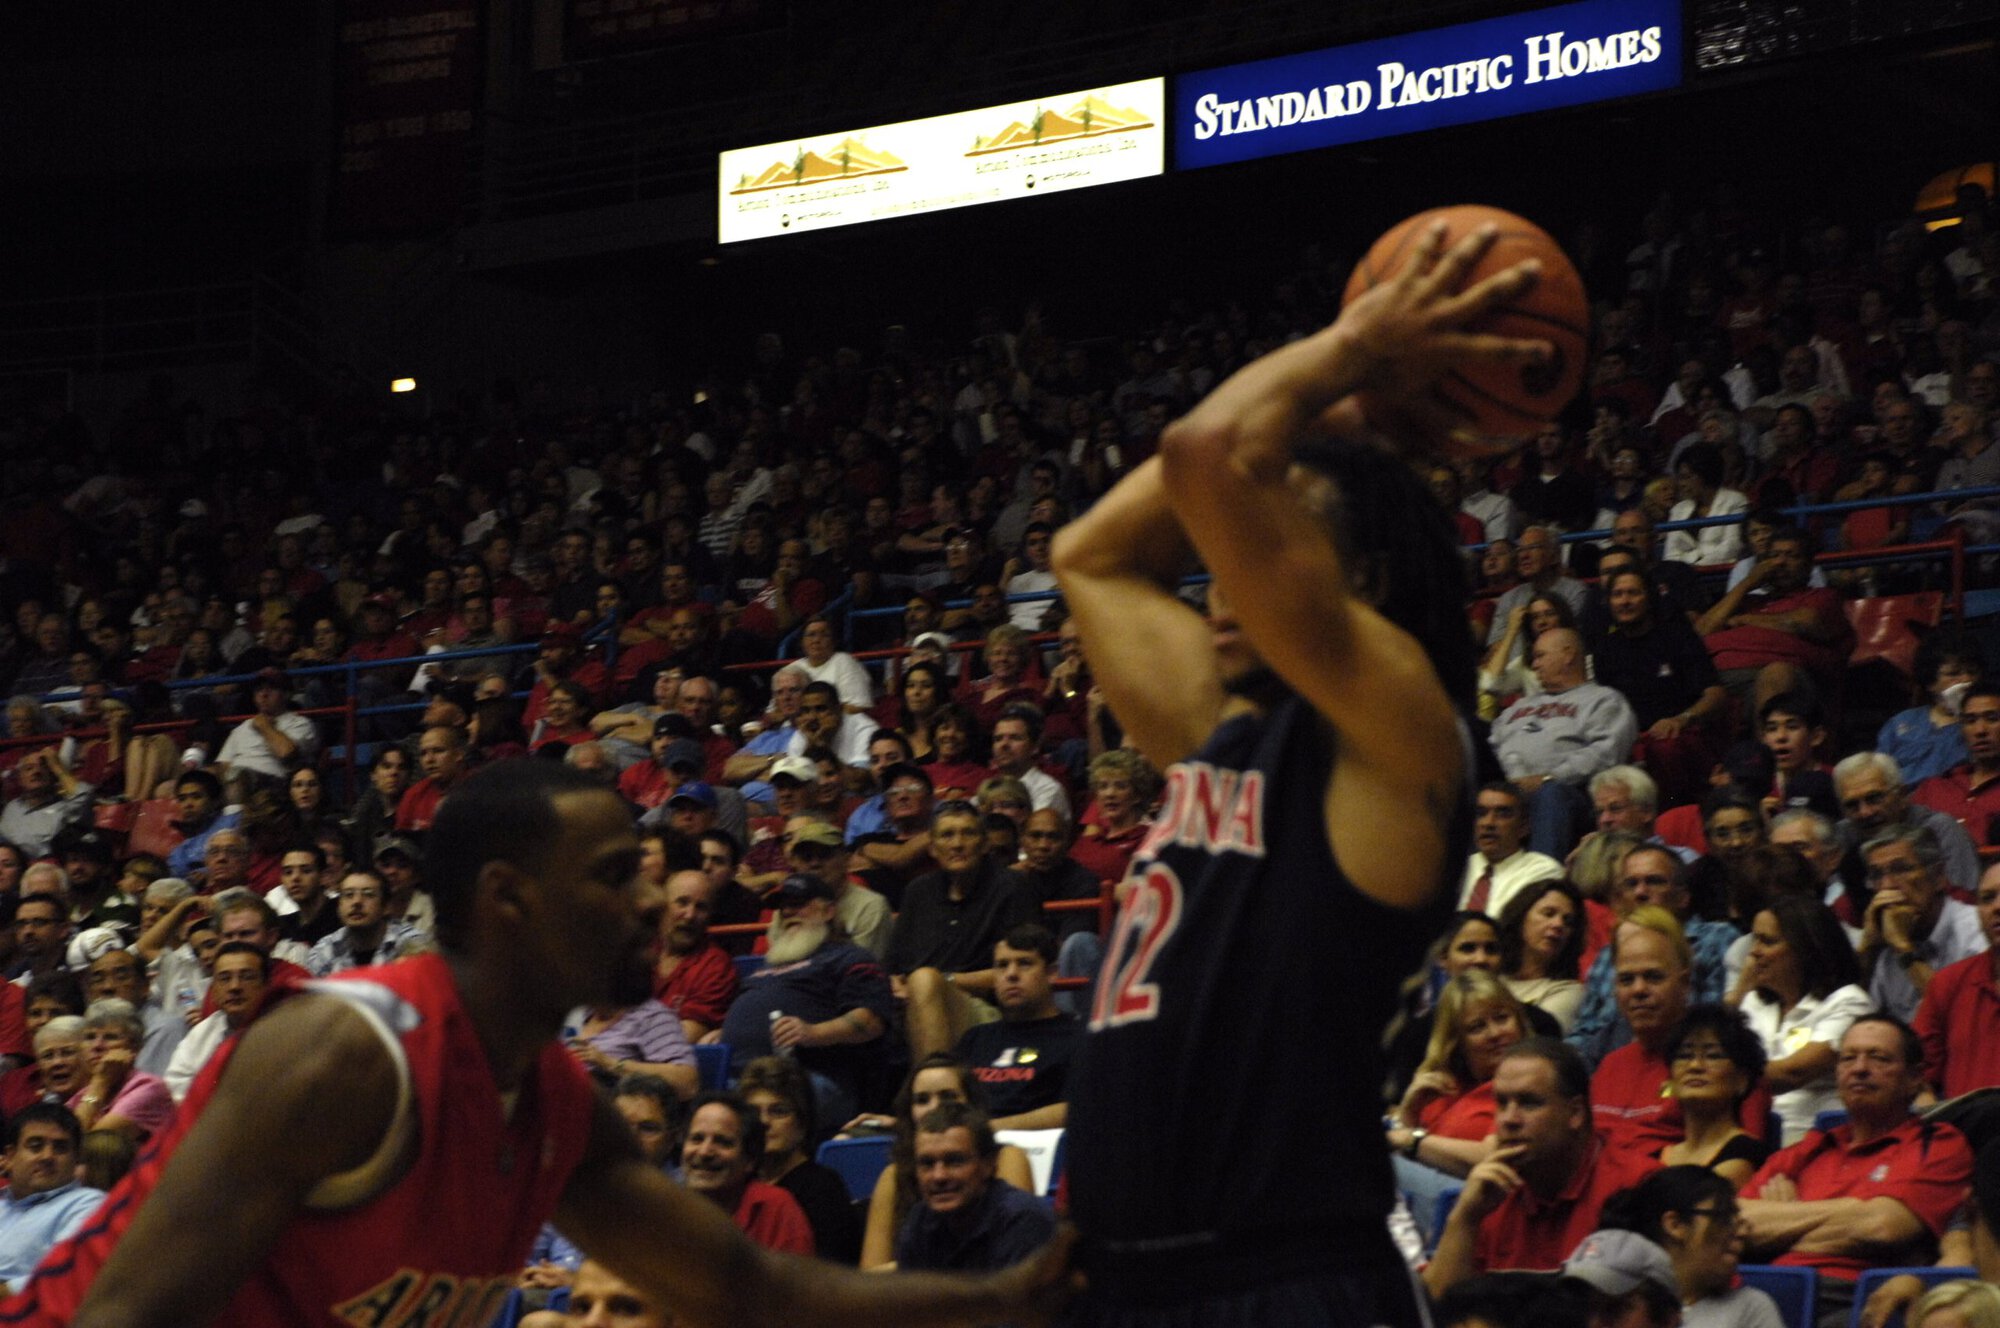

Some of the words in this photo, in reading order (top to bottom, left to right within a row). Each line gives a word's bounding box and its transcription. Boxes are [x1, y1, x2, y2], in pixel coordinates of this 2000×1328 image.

[1194, 80, 1372, 140] STANDARD
[1377, 54, 1513, 110] PACIFIC
[1524, 26, 1662, 85] HOMES
[1087, 860, 1184, 1032] 12
